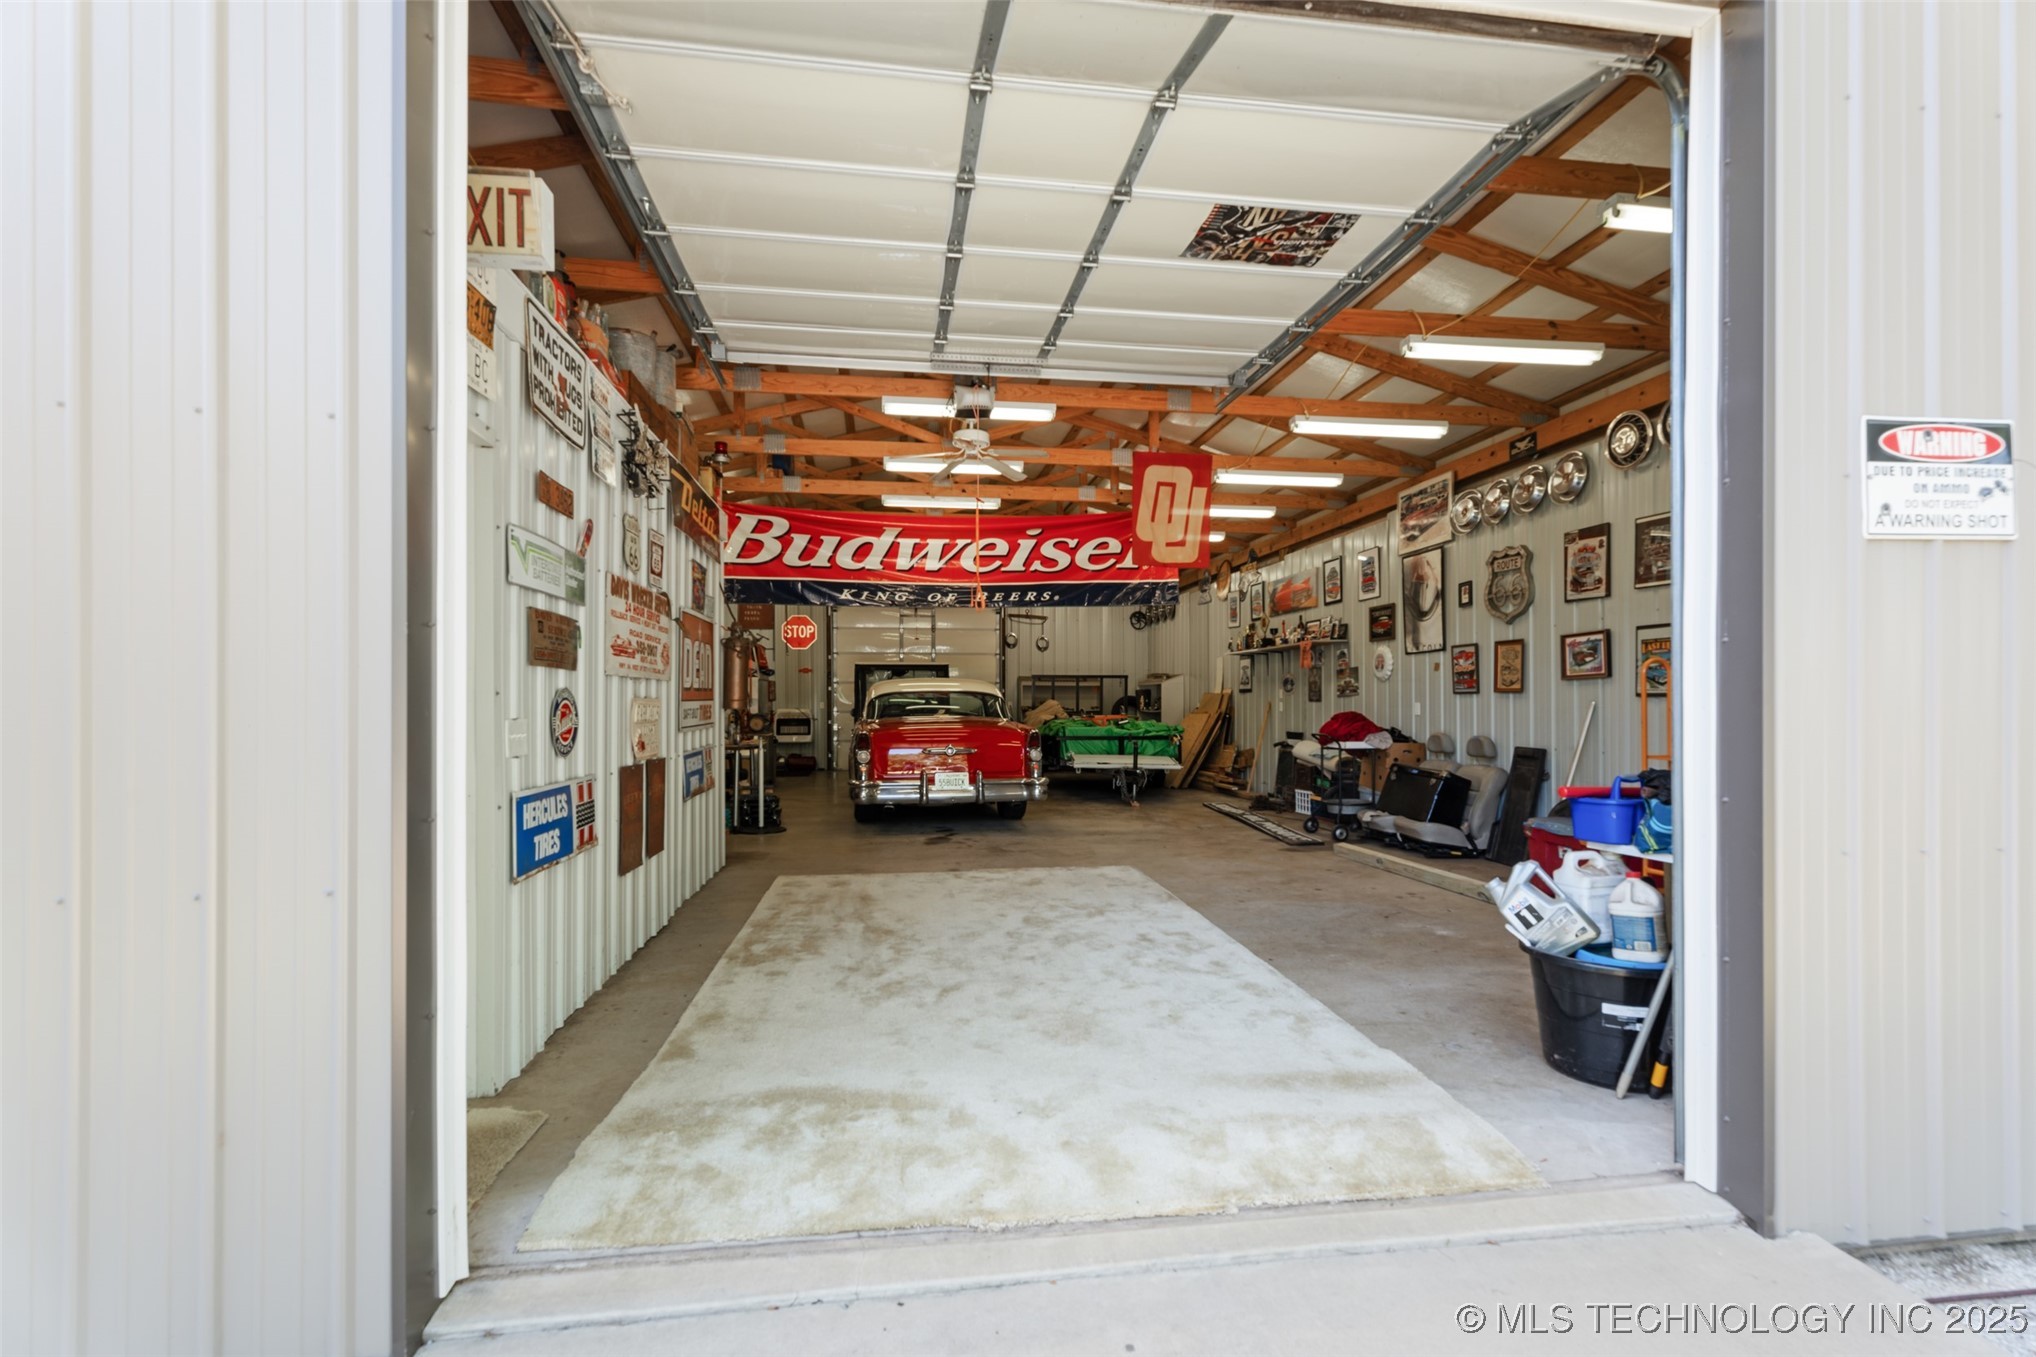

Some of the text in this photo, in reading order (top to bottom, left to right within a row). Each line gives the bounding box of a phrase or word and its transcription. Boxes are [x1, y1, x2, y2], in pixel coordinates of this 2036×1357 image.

[467, 185, 532, 248] XIT
[532, 316, 583, 384] TRACTORS
[532, 344, 555, 385] WITH
[1896, 430, 1988, 457] WARNING
[1874, 465, 1895, 477] DUE
[1900, 466, 1914, 477] TO
[1917, 466, 1950, 478] PRICE
[1136, 464, 1208, 564] OU
[1904, 499, 1979, 509] DO NOT EXPECT
[1874, 514, 2009, 528] A WARNING SHOT
[629, 546, 639, 568] 66
[1496, 557, 1519, 570] ROUTE
[838, 588, 910, 602] KING
[927, 592, 958, 603] OF
[1492, 573, 1522, 608] 66
[784, 624, 815, 639] STOP
[683, 637, 712, 689] DEAN
[523, 793, 569, 831] HERCULES
[534, 828, 561, 862] TIRES
[1520, 908, 1538, 926] 1
